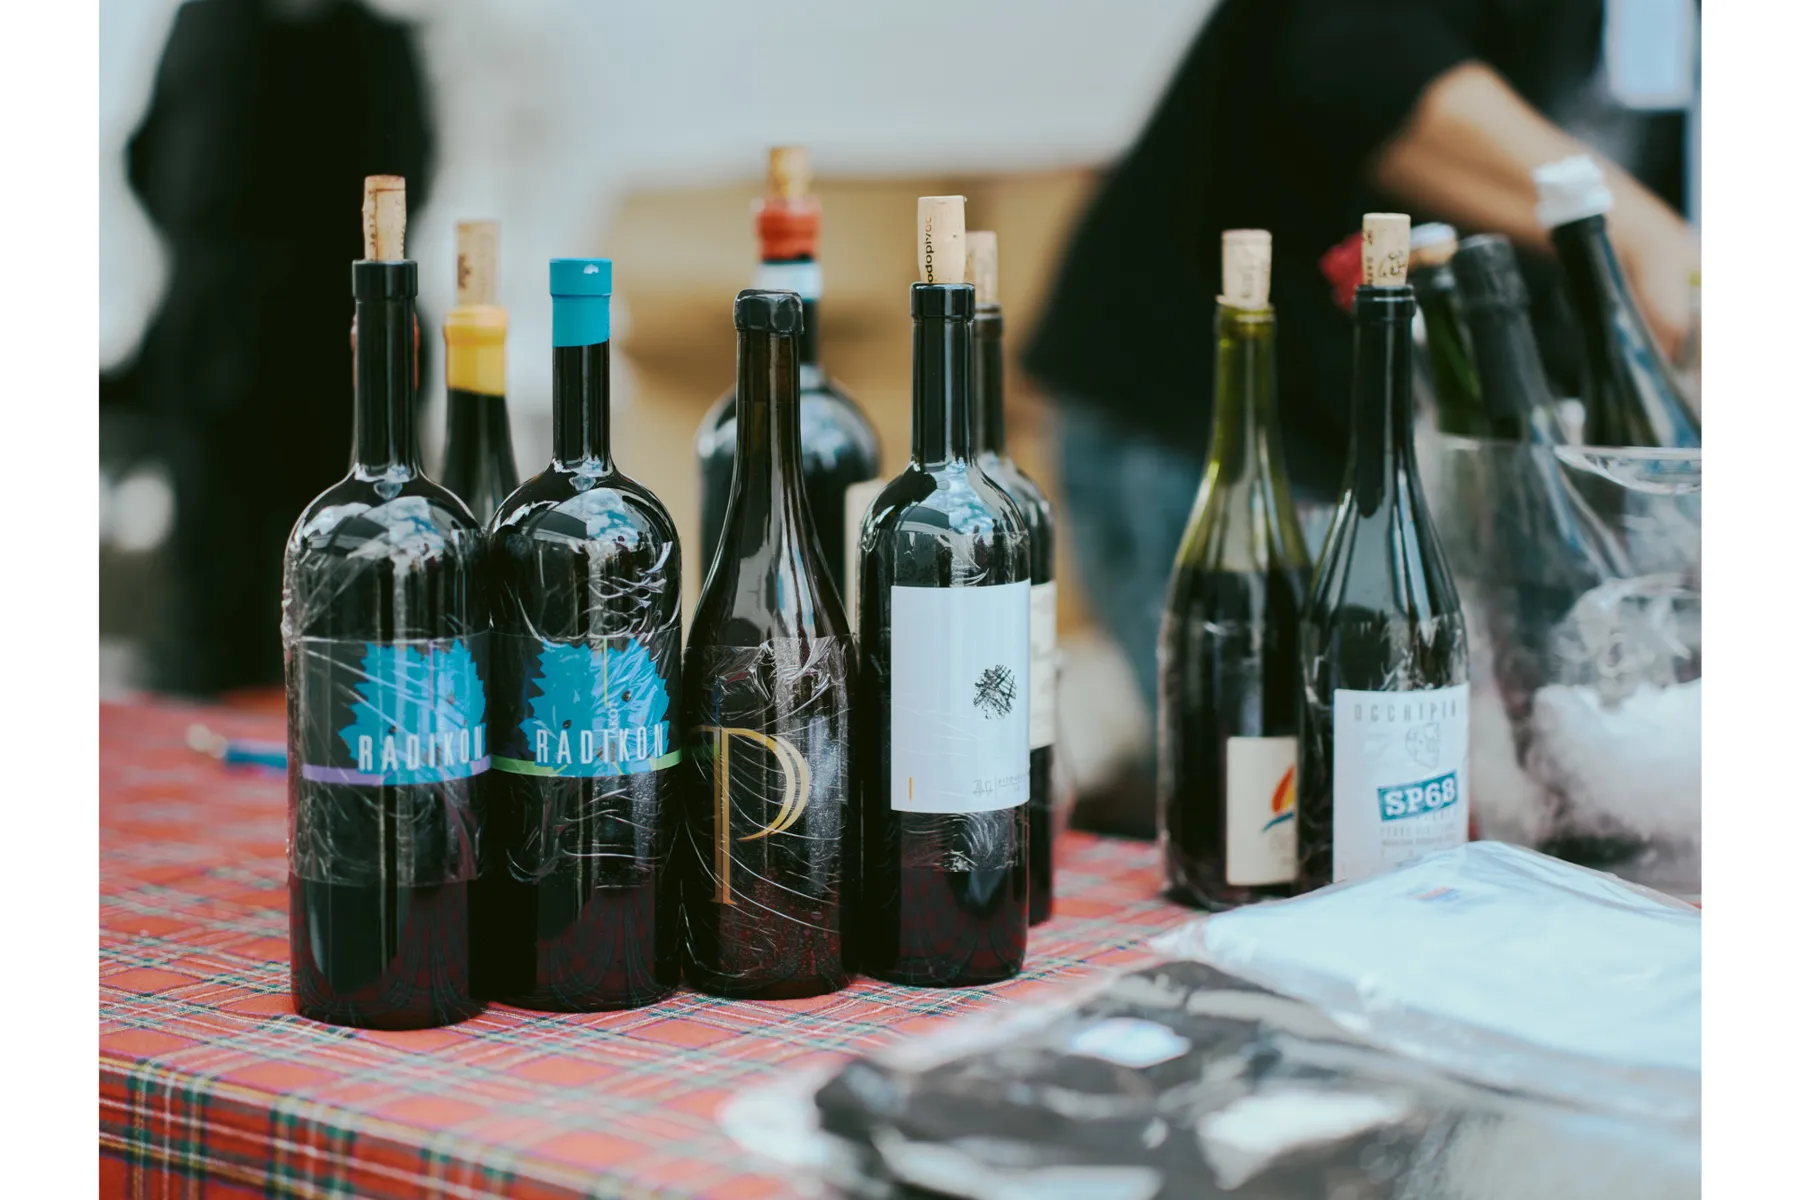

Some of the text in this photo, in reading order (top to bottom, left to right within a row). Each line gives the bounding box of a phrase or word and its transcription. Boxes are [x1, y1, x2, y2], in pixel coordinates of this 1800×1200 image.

[358, 725, 485, 771] RADIKON
[535, 724, 665, 765] RADIKON
[690, 727, 809, 905] P
[1384, 777, 1456, 817] SP68
